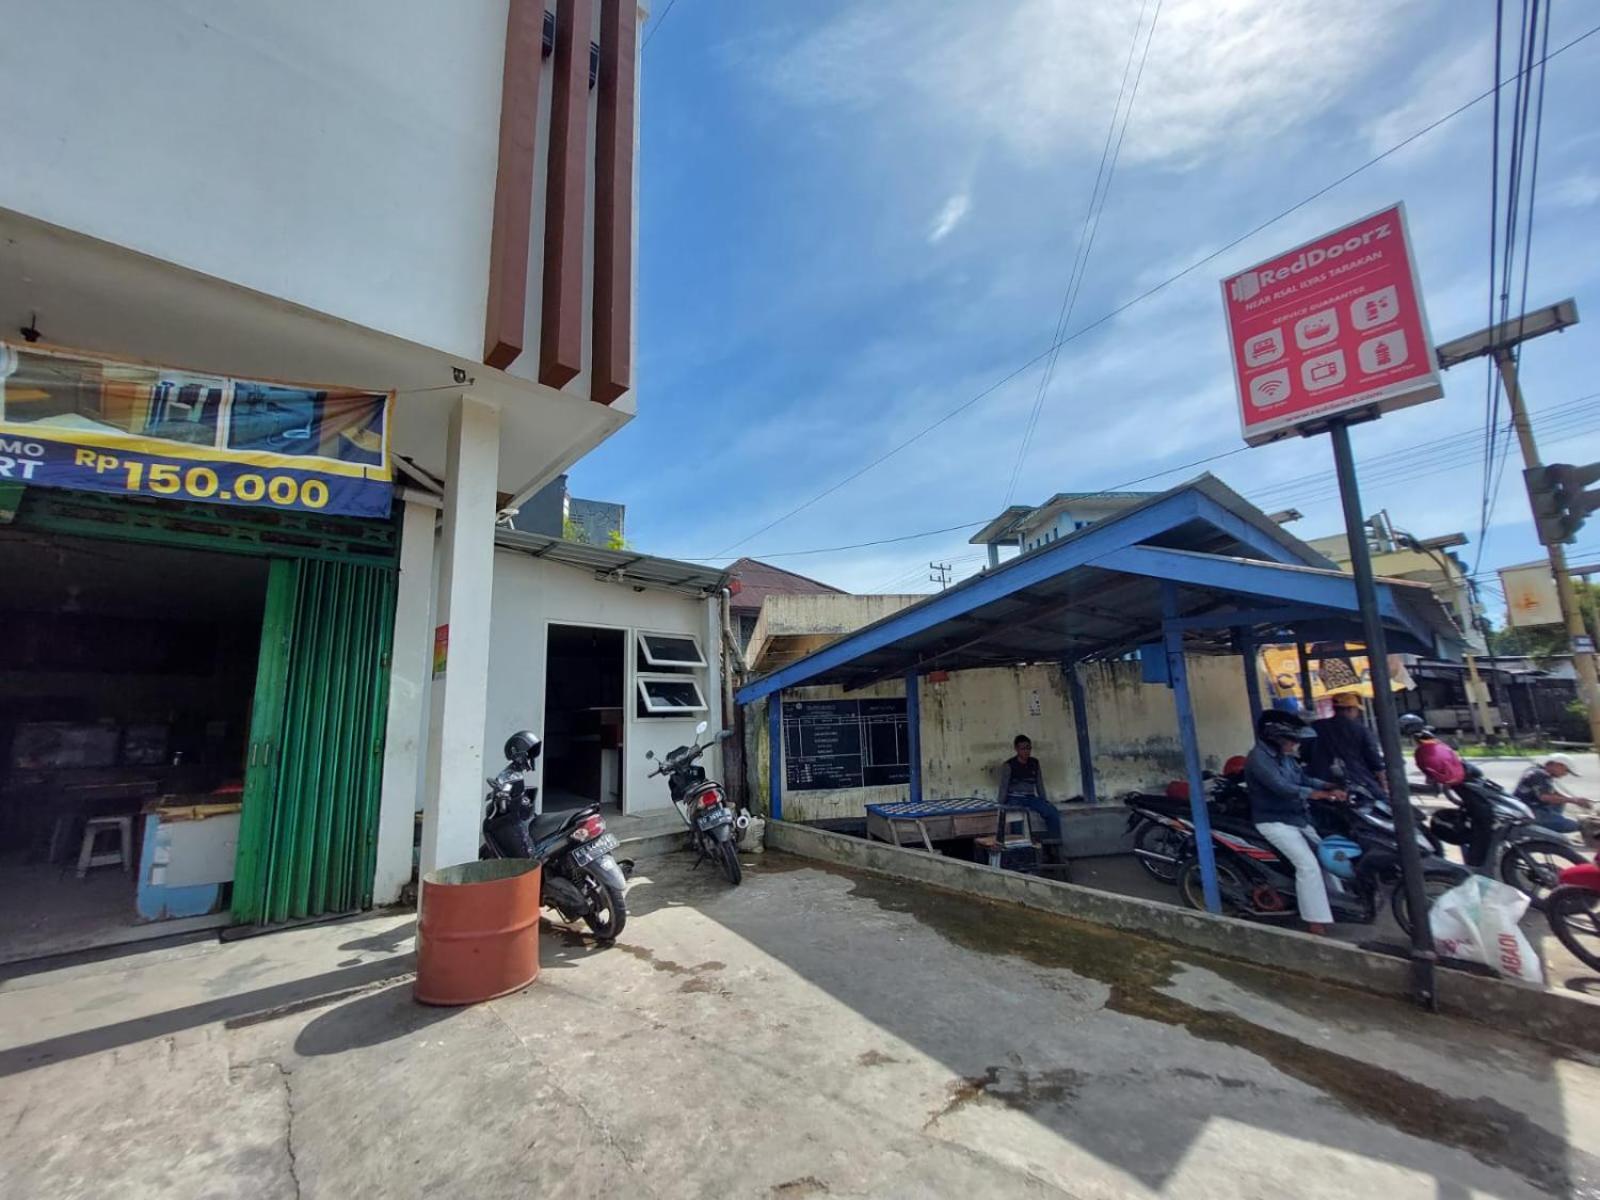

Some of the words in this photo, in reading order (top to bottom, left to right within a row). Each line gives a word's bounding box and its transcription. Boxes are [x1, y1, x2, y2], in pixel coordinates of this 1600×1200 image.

[1245, 295, 1271, 311] NEAR
[1330, 250, 1383, 277] TARAKAN
[1259, 223, 1392, 287] RedDoorz
